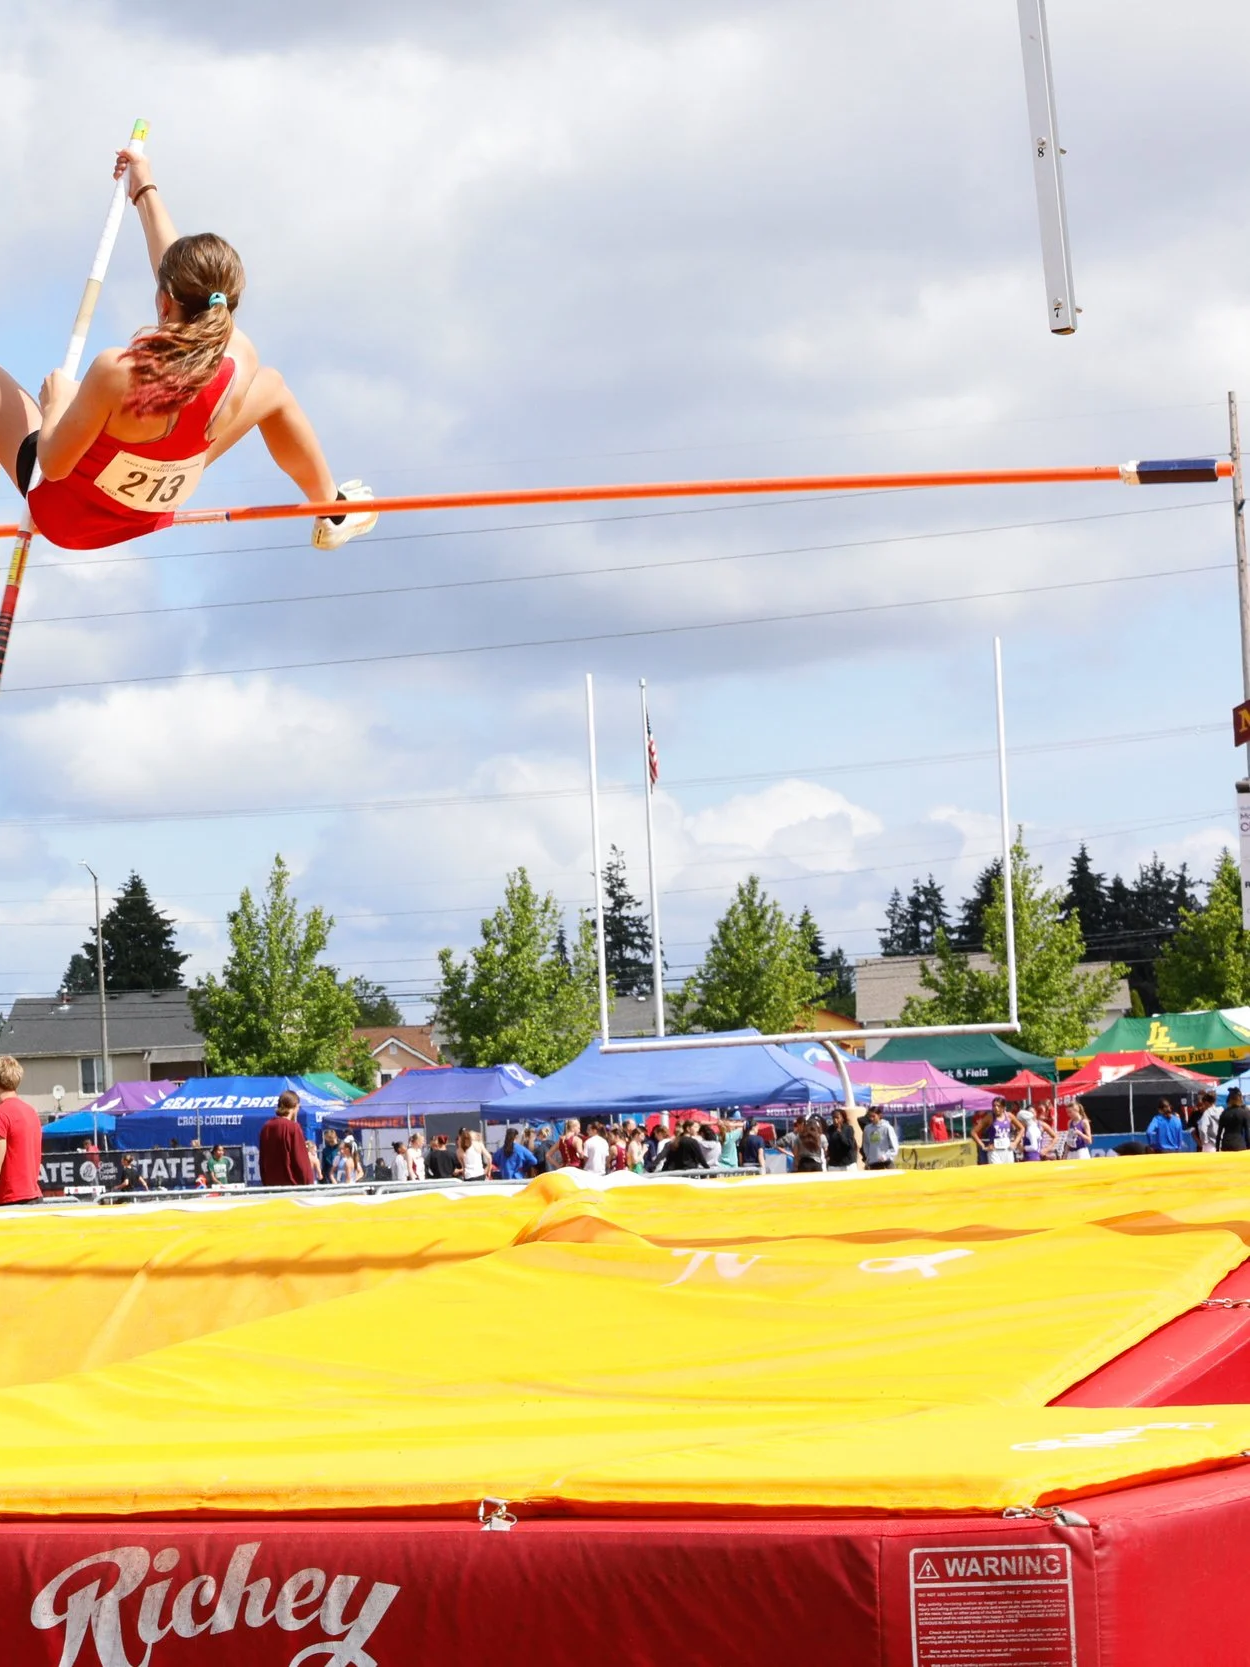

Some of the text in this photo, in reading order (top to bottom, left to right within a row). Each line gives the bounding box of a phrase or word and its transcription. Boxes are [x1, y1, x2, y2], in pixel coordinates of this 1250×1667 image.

[1037, 146, 1045, 158] 8
[1053, 307, 1060, 318] 7
[117, 470, 186, 503] 213
[966, 1068, 989, 1078] Field
[160, 1095, 238, 1110] SEATTLE
[177, 1115, 244, 1127] CROSS COUNTRY
[944, 1554, 1061, 1577] WARNING
[30, 1541, 401, 1667] Richey
